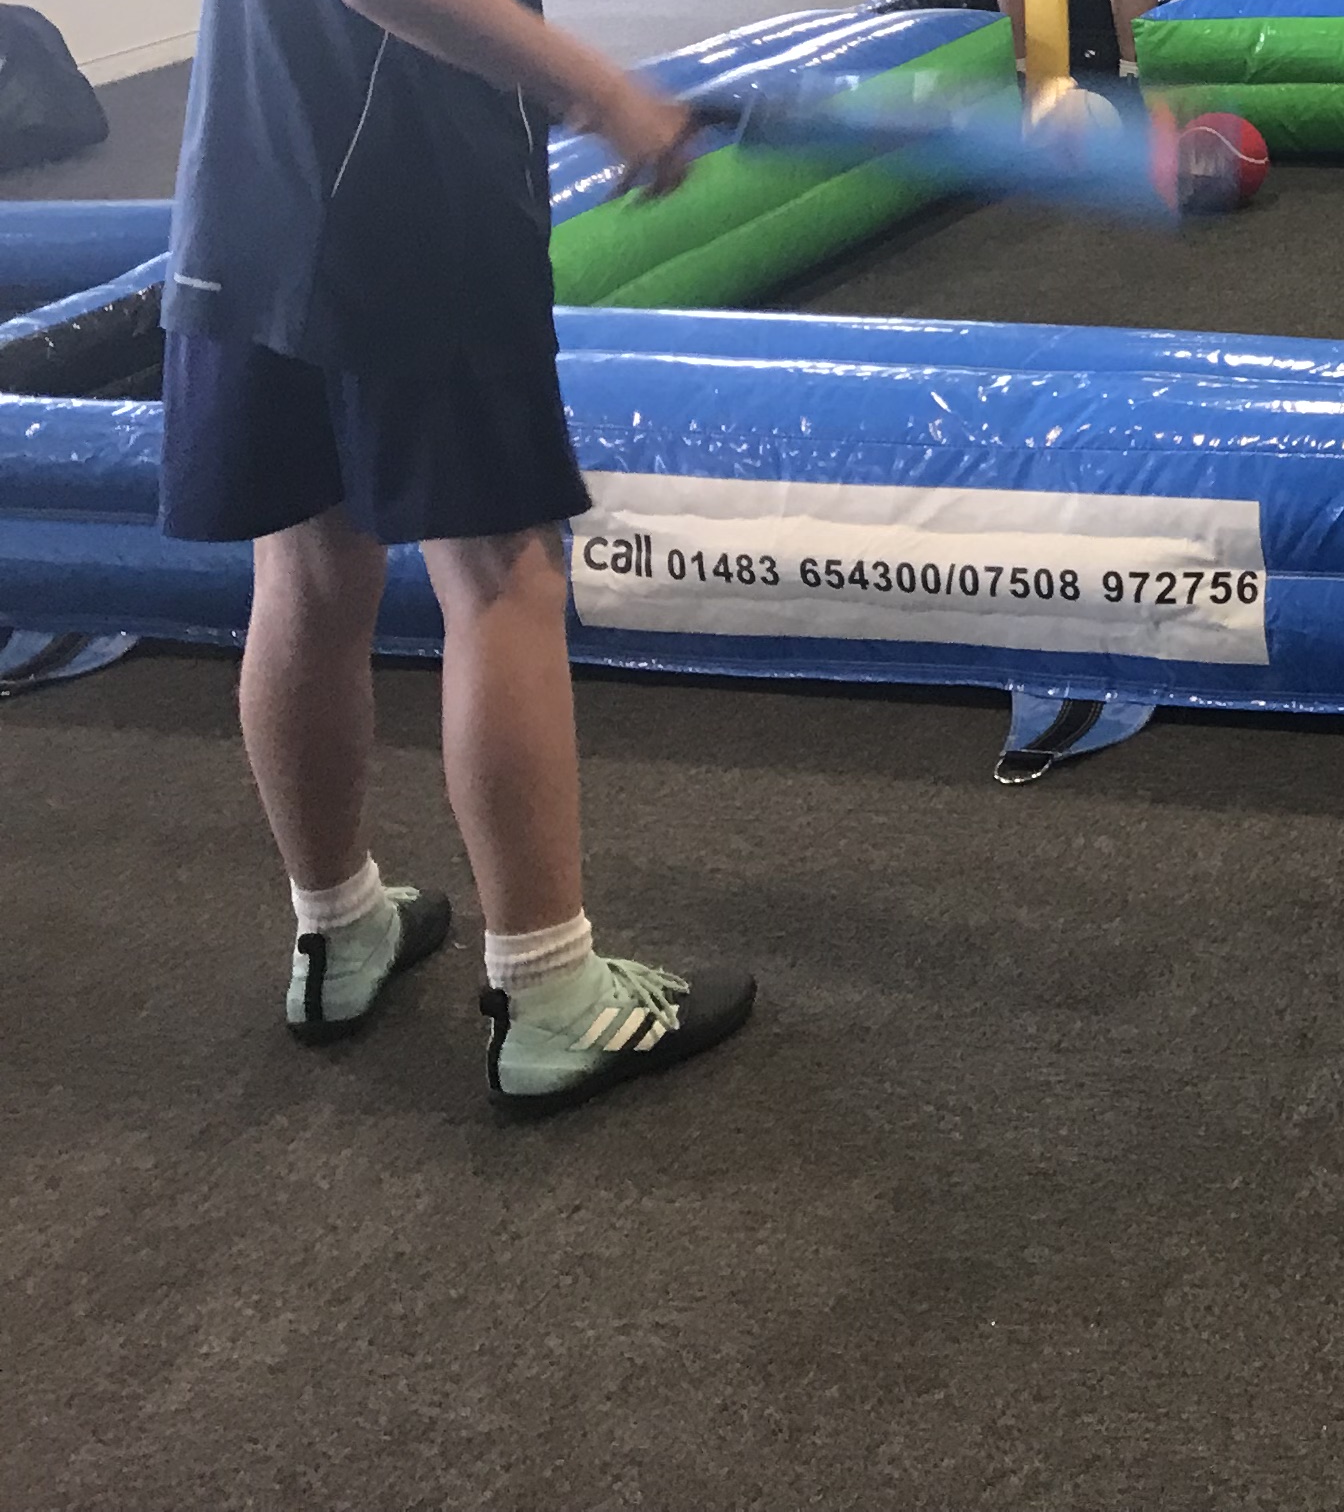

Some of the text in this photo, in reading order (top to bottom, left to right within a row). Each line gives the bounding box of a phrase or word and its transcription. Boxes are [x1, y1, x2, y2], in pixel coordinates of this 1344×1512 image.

[584, 533, 1258, 605] call 01483 654300/07508 972756
